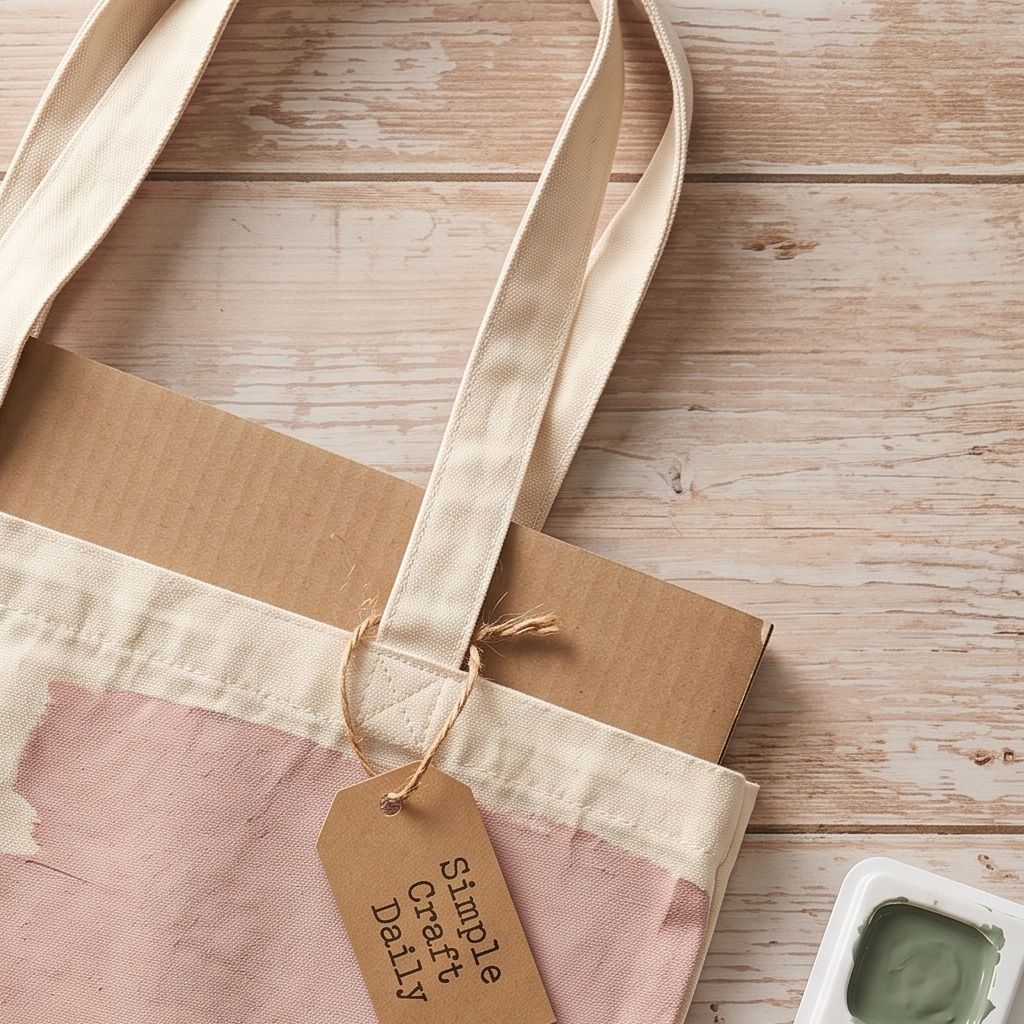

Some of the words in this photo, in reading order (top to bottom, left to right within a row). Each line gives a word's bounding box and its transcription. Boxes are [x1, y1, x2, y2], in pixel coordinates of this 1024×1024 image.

[371, 897, 428, 1001] Daily
[407, 880, 463, 983] Craft
[439, 857, 502, 984] Simple
